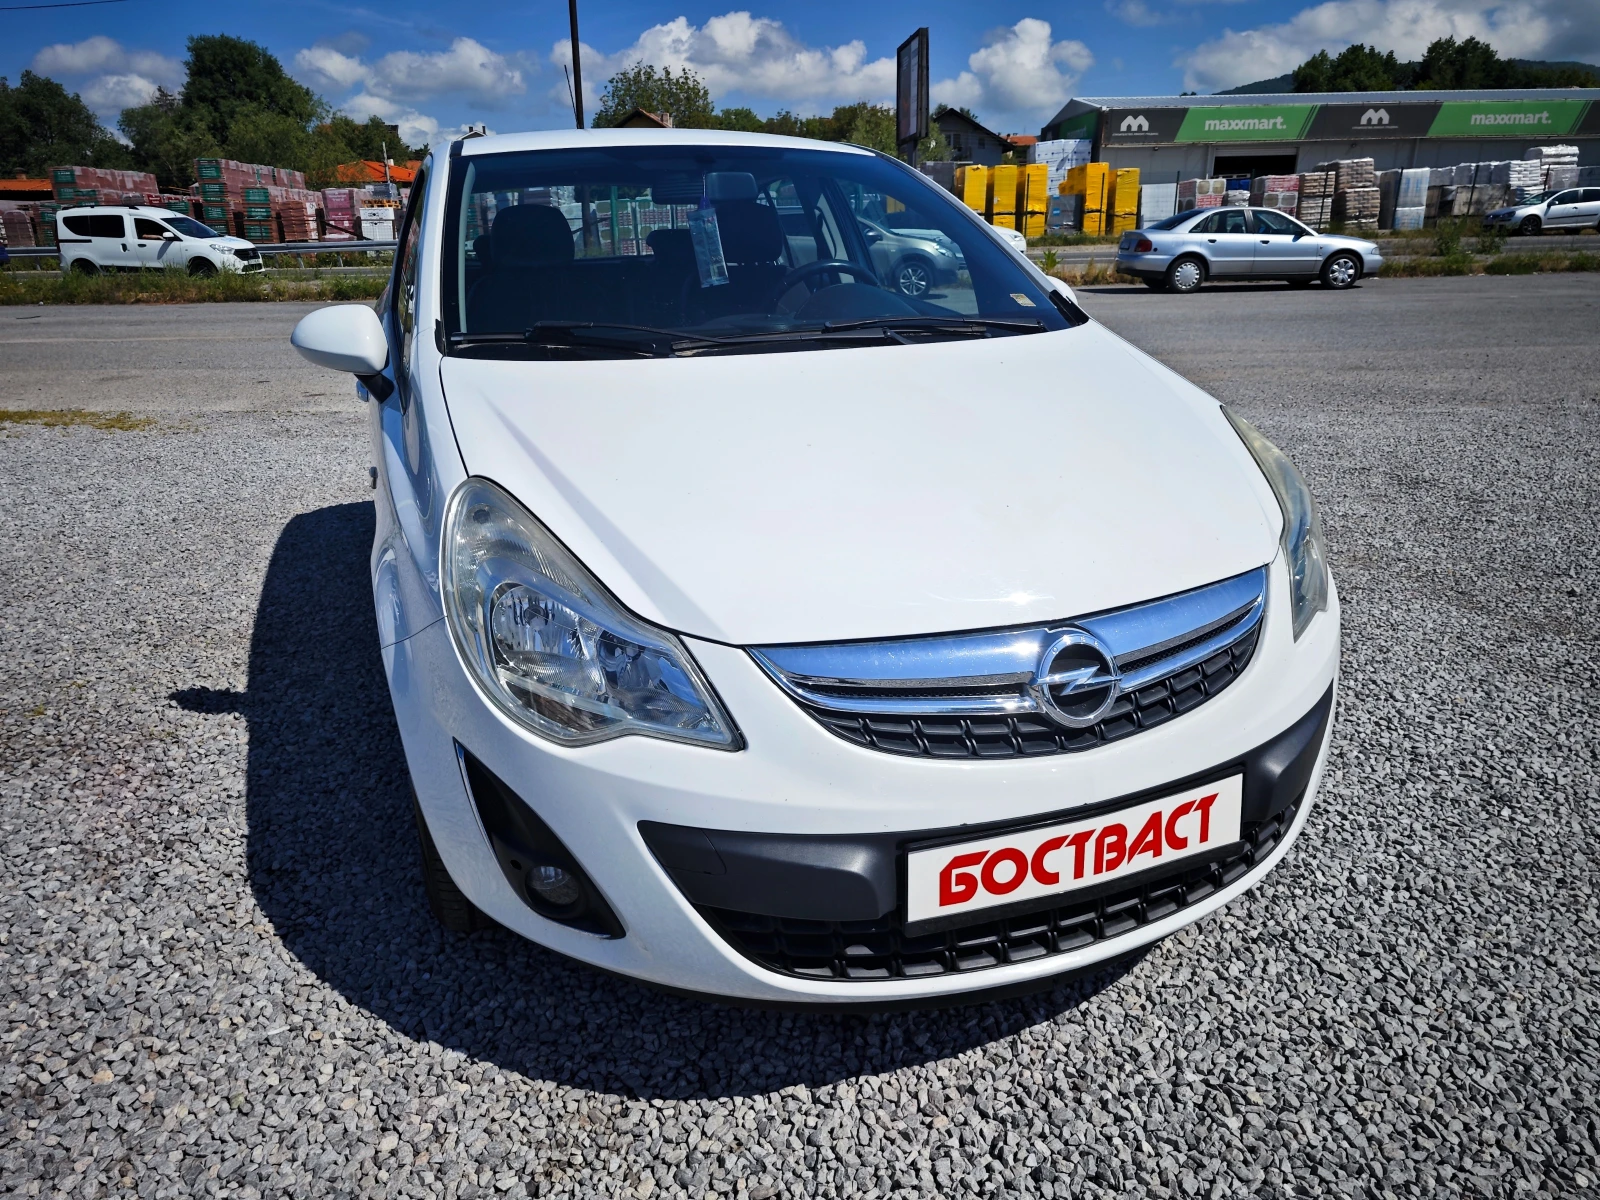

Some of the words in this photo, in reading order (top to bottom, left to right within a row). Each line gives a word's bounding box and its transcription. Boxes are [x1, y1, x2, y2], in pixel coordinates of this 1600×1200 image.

[1204, 116, 1287, 131] maxxmart.
[1470, 110, 1552, 125] maxxmart.
[939, 792, 1219, 907] БОСТВАСТ
